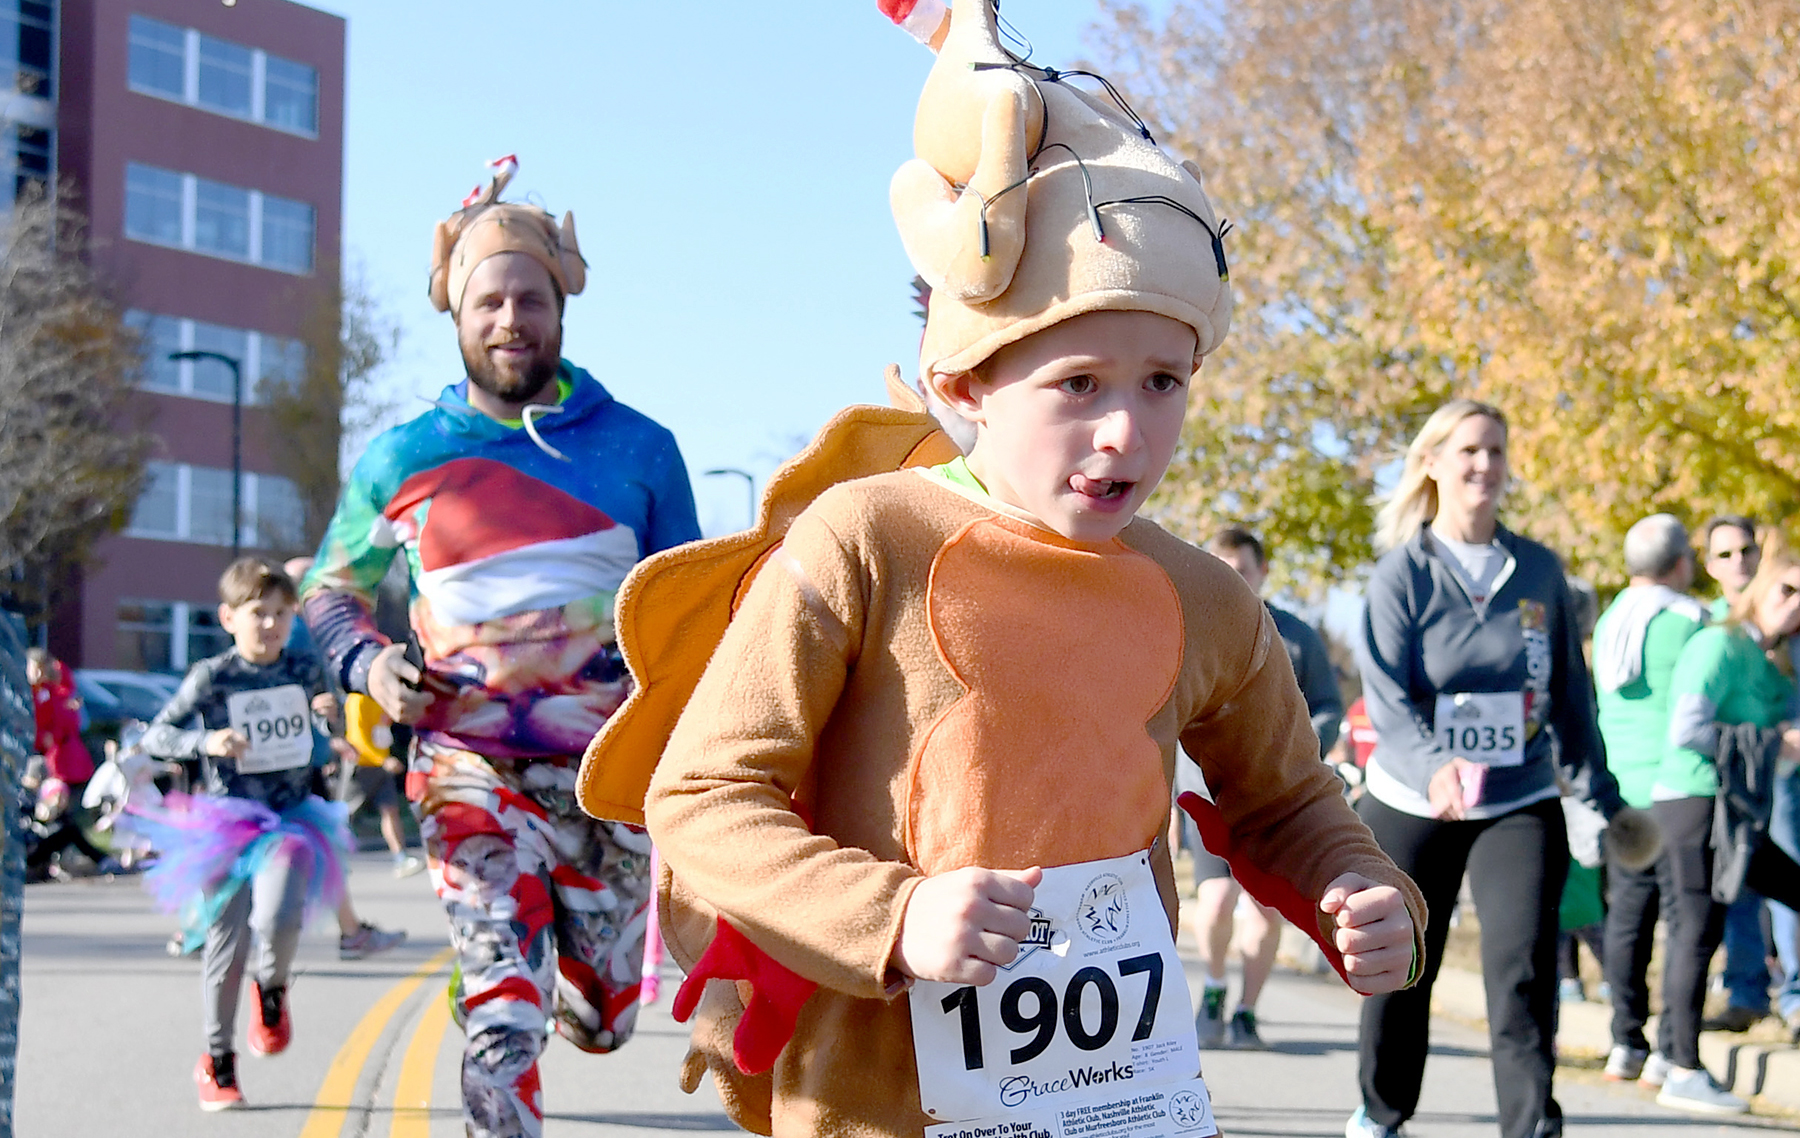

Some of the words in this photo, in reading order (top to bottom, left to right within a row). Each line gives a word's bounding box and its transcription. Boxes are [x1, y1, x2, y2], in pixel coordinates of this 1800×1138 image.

[242, 714, 304, 742] 1909
[1444, 726, 1516, 751] 1035
[940, 952, 1164, 1071] 1907
[1060, 1111, 1065, 1119] 3
[1065, 1110, 1076, 1119] day
[1076, 1106, 1091, 1115] FREE
[1092, 1099, 1131, 1113] membership
[1139, 1092, 1164, 1103] Franklin
[1063, 1118, 1086, 1127] Athletic
[1086, 1114, 1101, 1123] Club,
[1102, 1108, 1130, 1120] Nashville
[1131, 1103, 1155, 1114] Athletic
[960, 1130, 973, 1138] On
[974, 1128, 996, 1138] Over
[997, 1124, 1009, 1135] To
[1009, 1122, 1032, 1133] Your
[1064, 1127, 1077, 1136] Club
[1085, 1119, 1127, 1131] Murfreesboro
[1128, 1112, 1152, 1123] Athletic
[1152, 1109, 1166, 1119] Club
